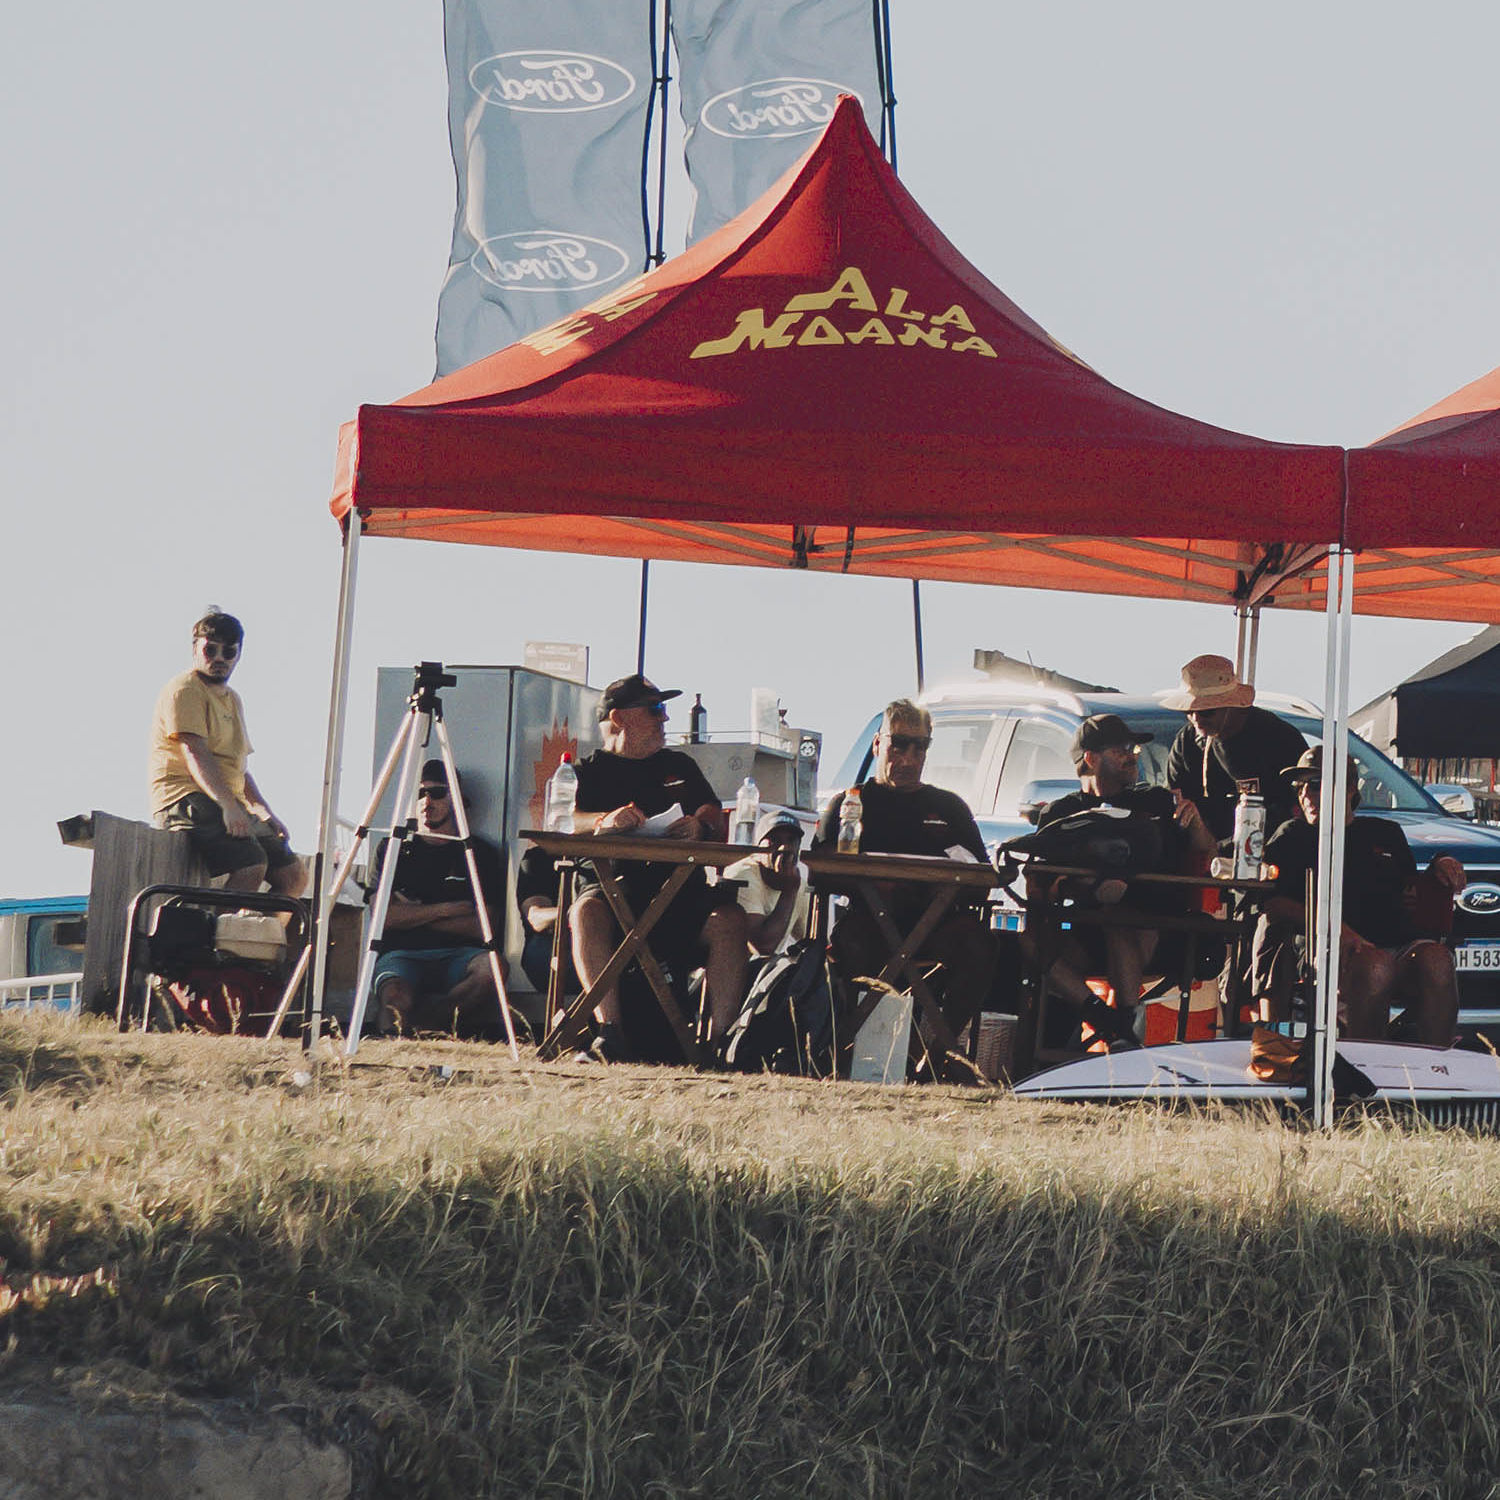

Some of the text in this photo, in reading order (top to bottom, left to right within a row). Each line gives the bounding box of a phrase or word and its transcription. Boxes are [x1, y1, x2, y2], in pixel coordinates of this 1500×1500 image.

[785, 267, 975, 332] ALA
[689, 309, 998, 359] MOANA
[1471, 893, 1498, 906] Ford
[1473, 950, 1500, 968] 583
